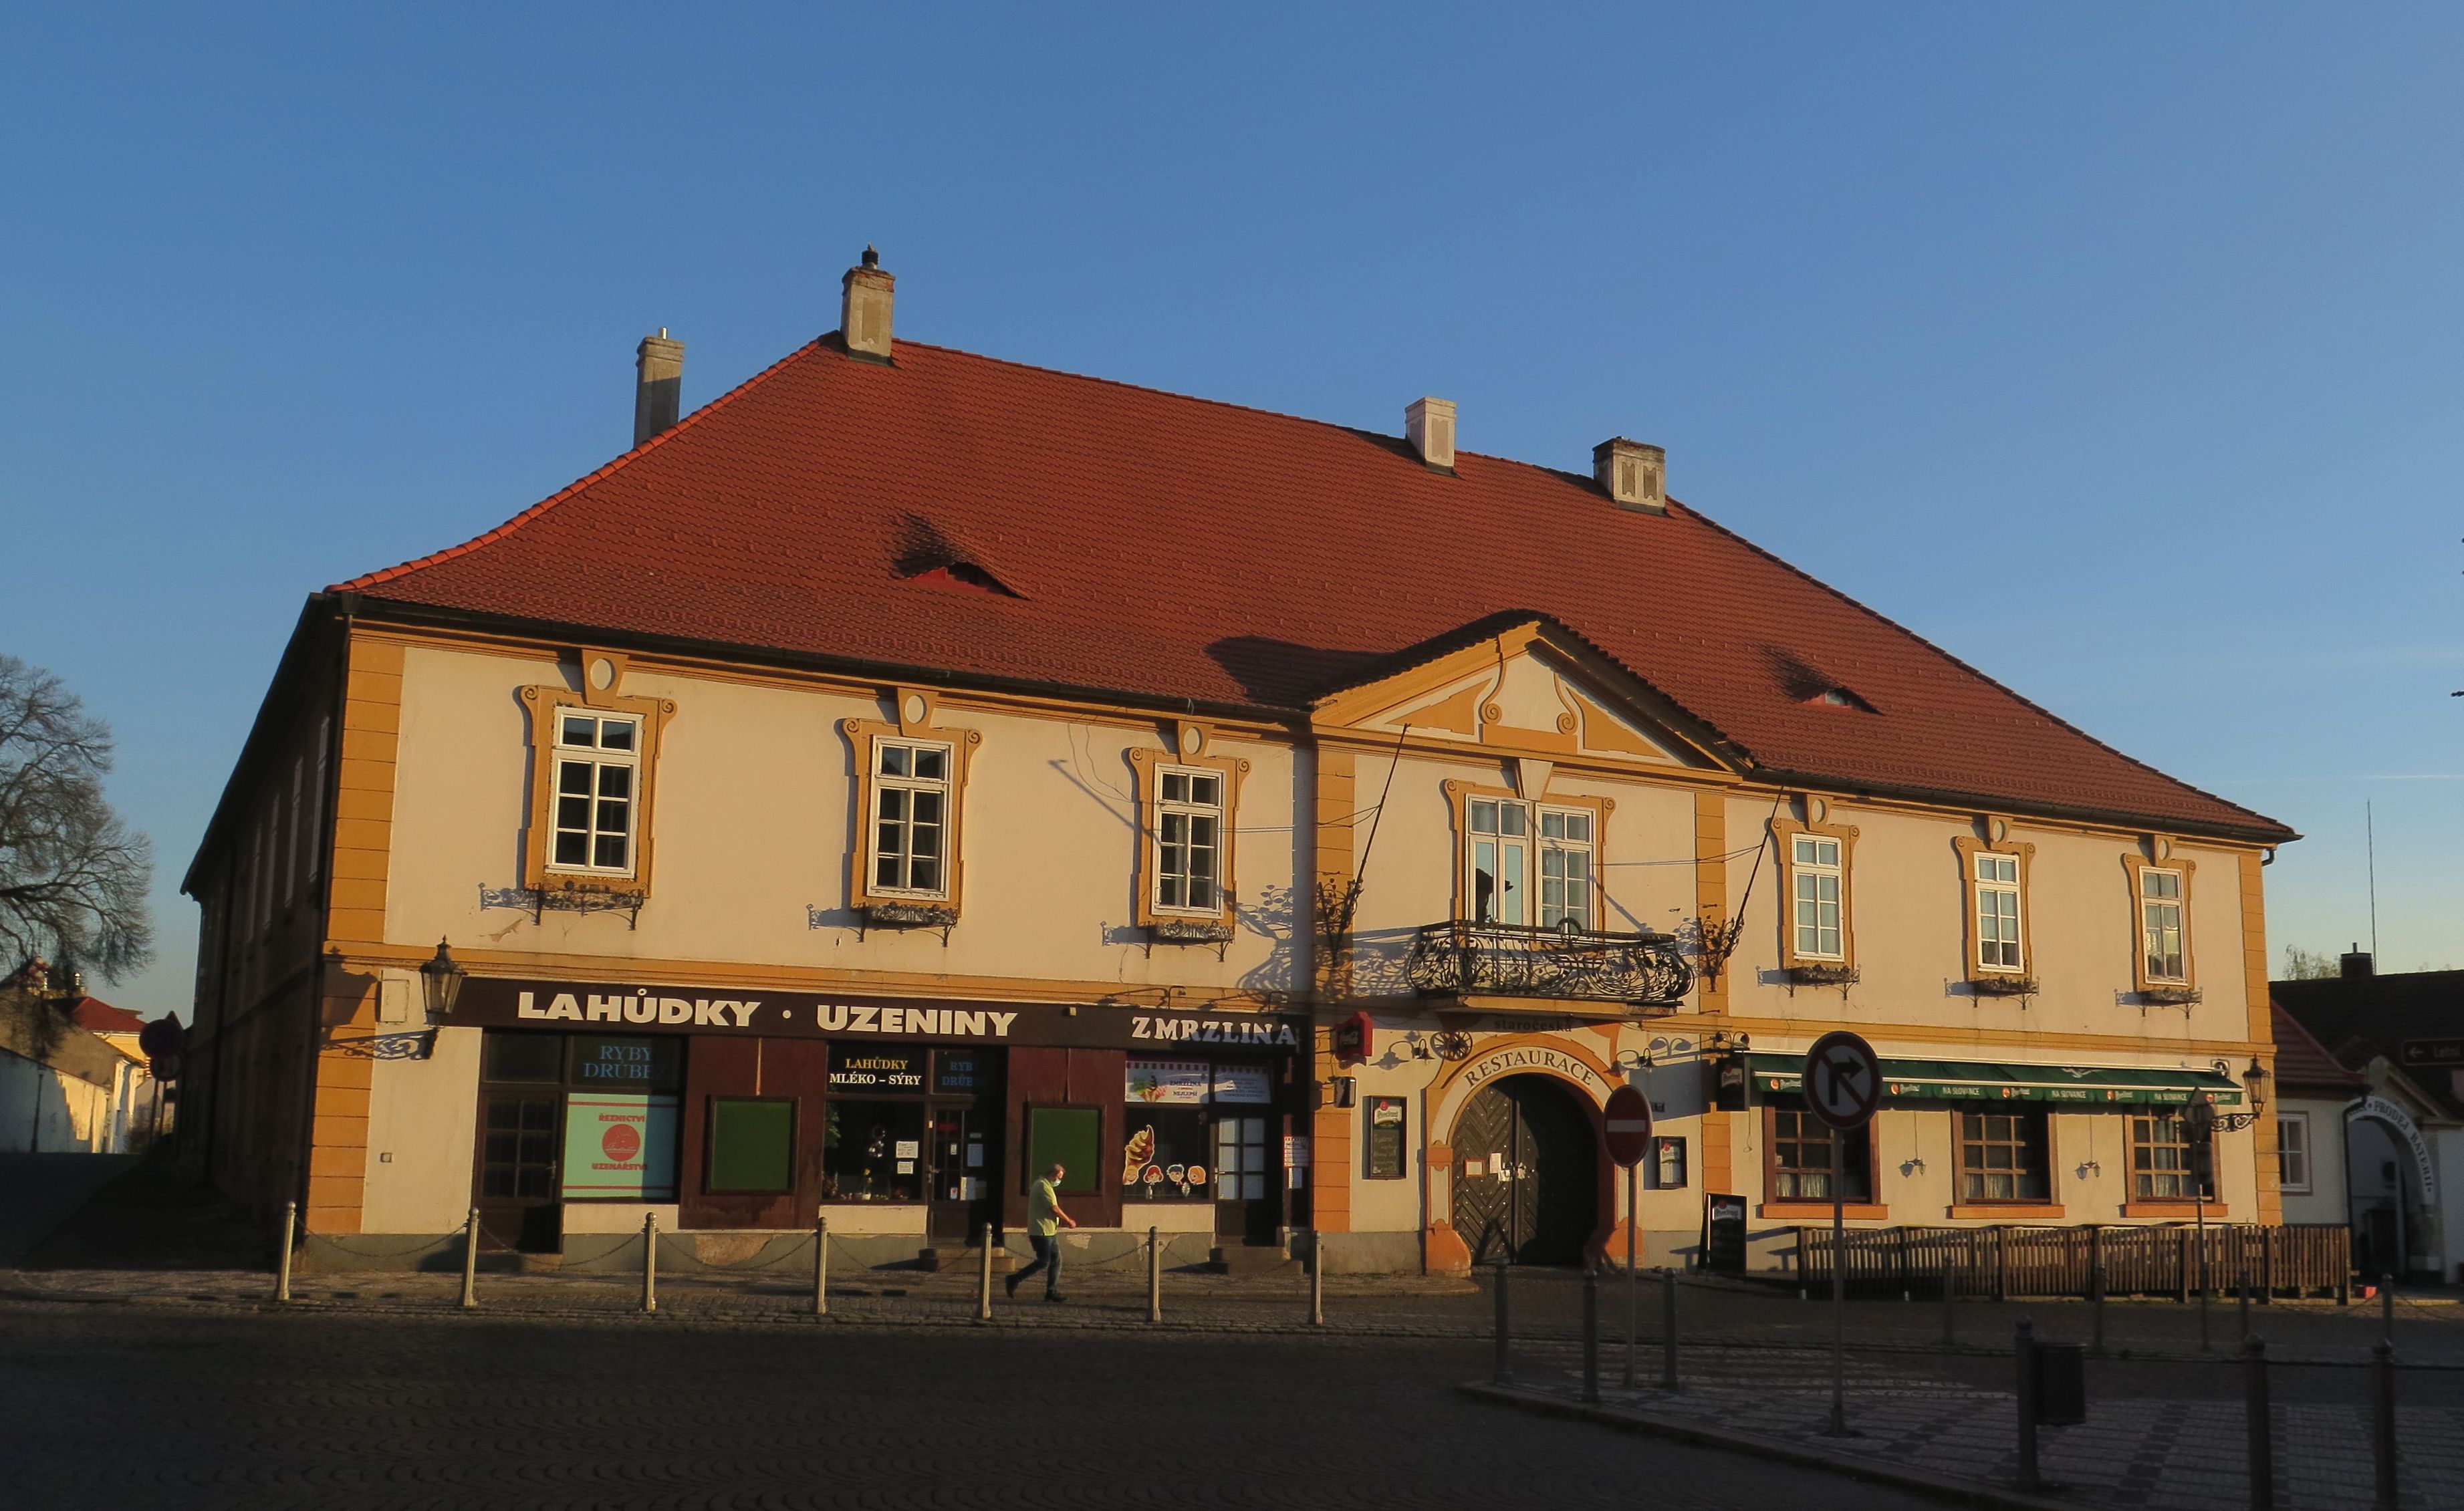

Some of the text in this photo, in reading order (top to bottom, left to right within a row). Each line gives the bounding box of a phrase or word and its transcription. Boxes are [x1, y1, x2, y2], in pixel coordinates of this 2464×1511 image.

[518, 988, 1018, 1037] LAHŮDKY UZENINY
[1131, 1016, 1296, 1045] ZMRZLINA
[1494, 1018, 1572, 1032] staročeská
[599, 1045, 653, 1061] RYBY
[845, 1056, 908, 1070] LAHŮDKY
[950, 1061, 980, 1072] RYB
[1464, 1051, 1594, 1087] RESTAURACE
[830, 1071, 876, 1084] MLÉKO
[888, 1072, 922, 1085] SÝRY
